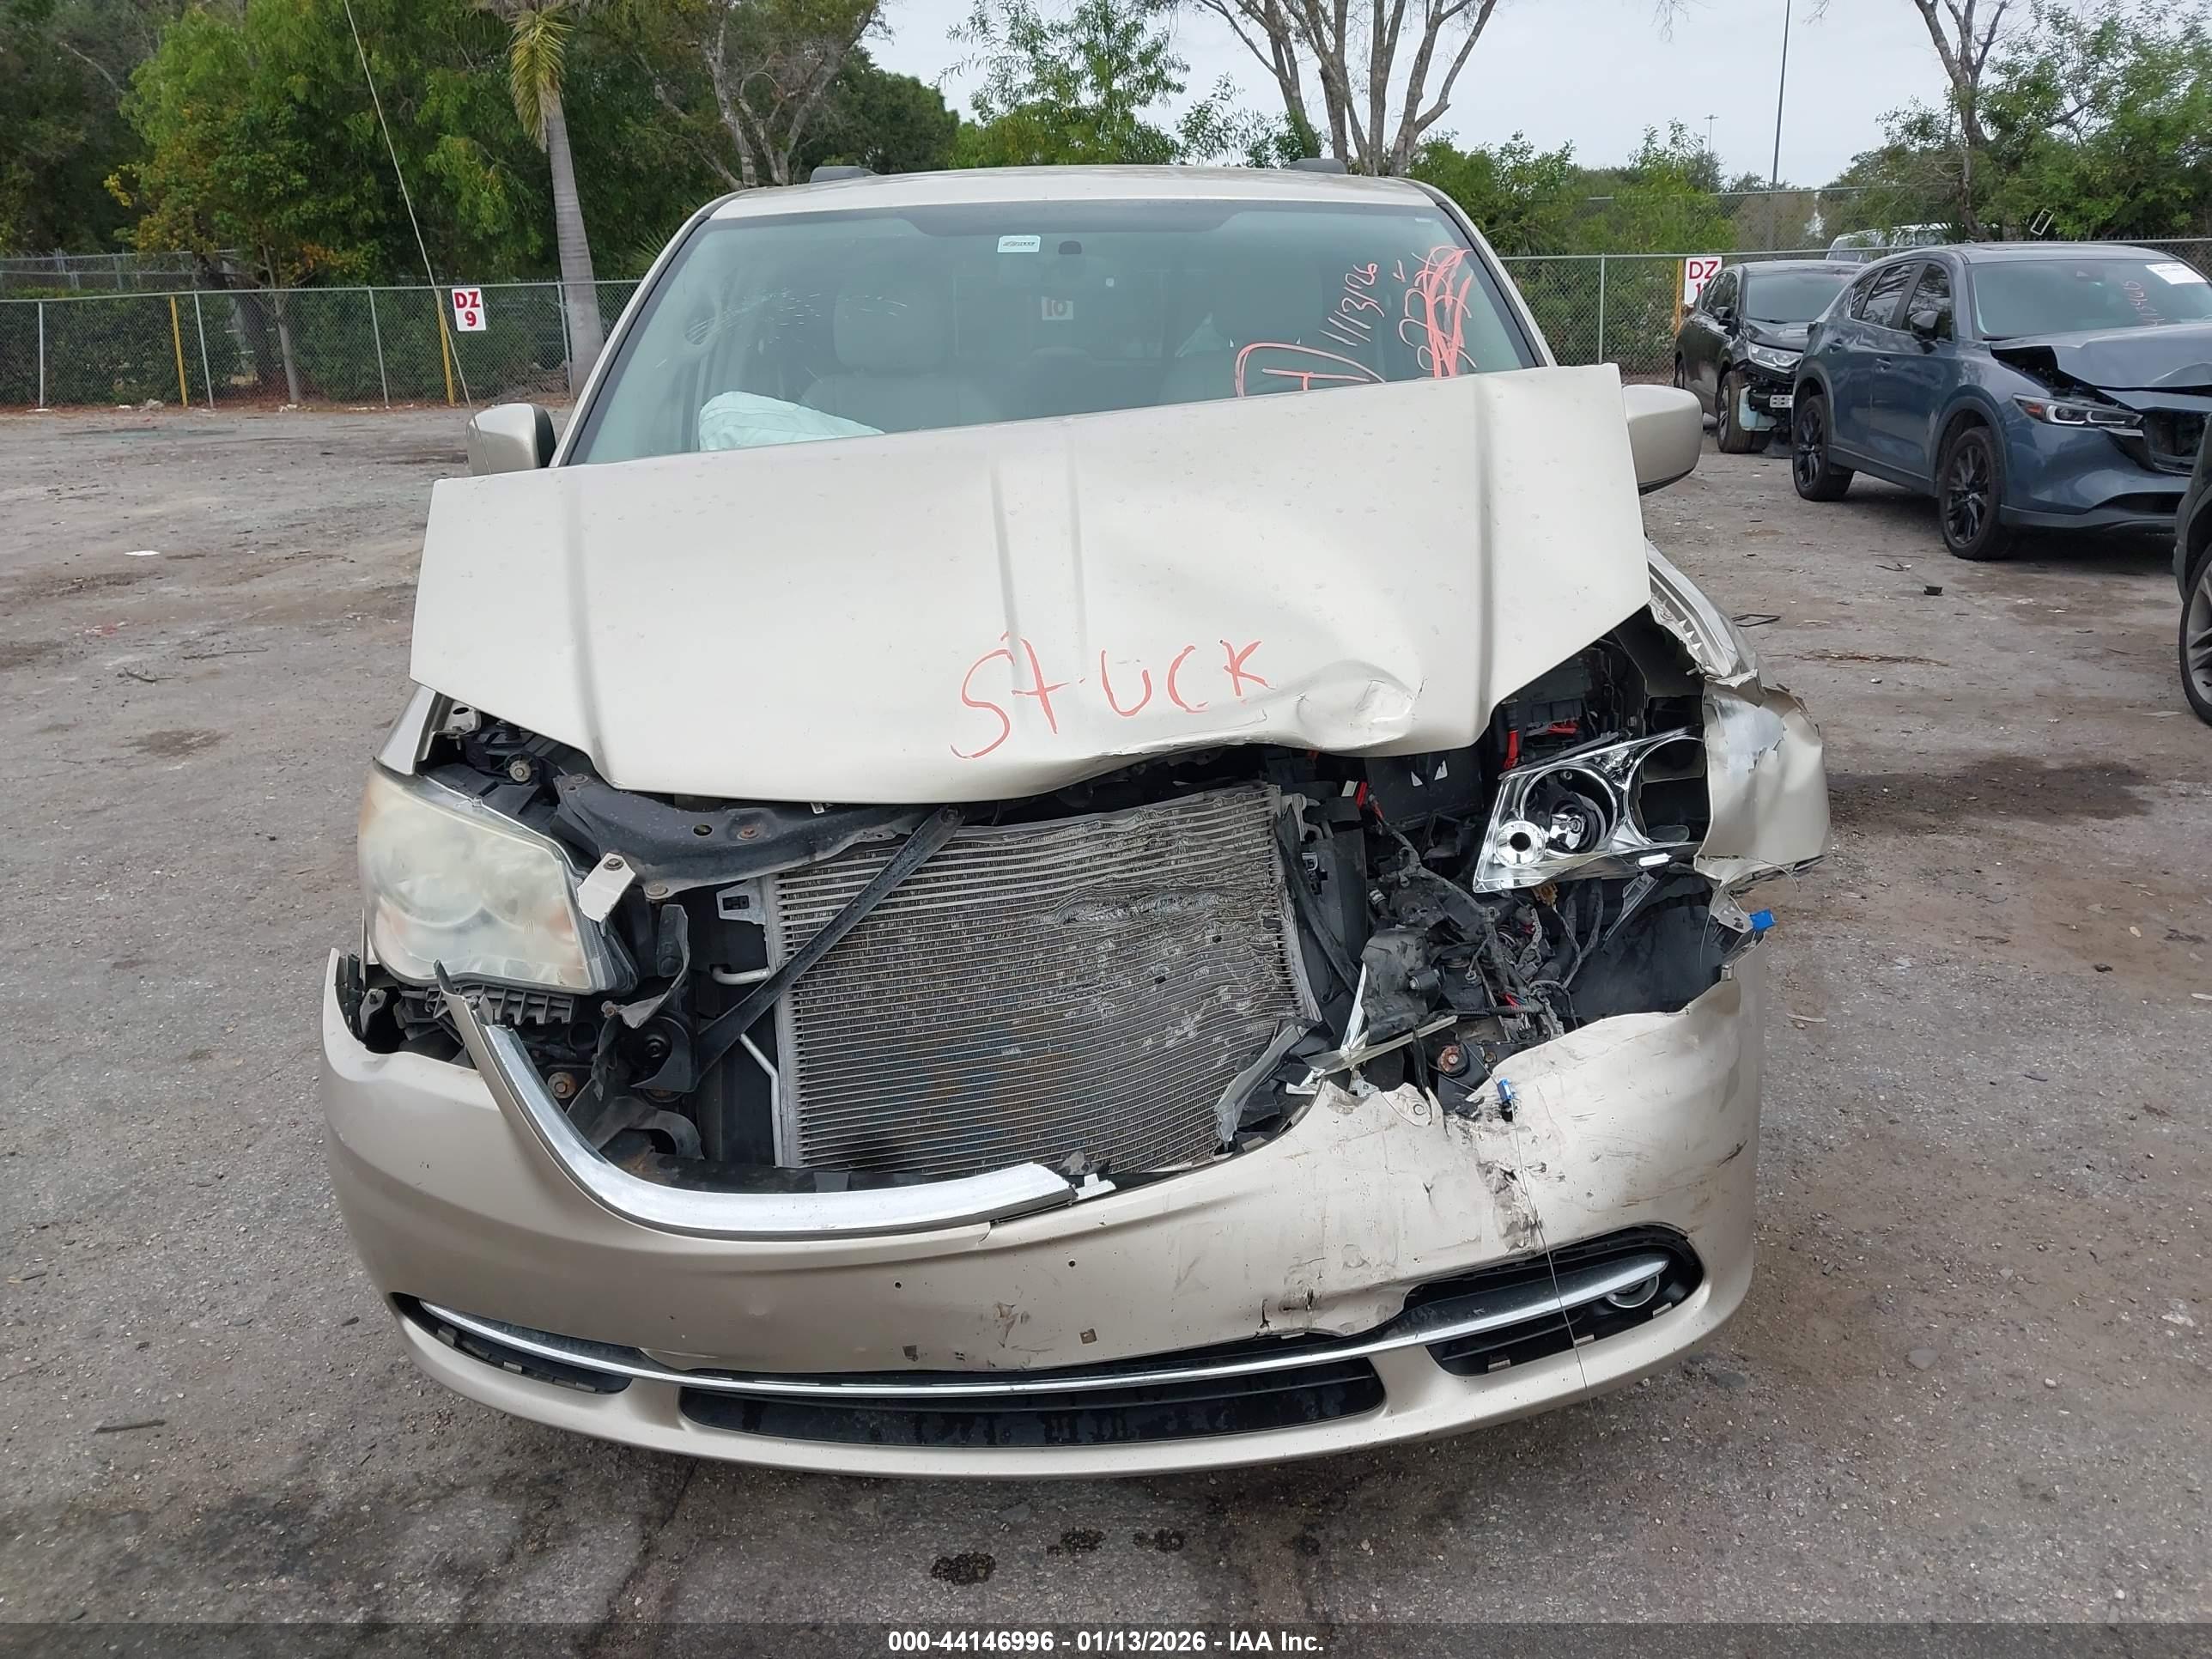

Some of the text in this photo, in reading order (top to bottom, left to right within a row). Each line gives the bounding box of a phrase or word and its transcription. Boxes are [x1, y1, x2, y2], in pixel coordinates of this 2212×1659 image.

[1689, 261, 1718, 280] DZ
[453, 291, 480, 309] DZ
[465, 311, 477, 327] 9
